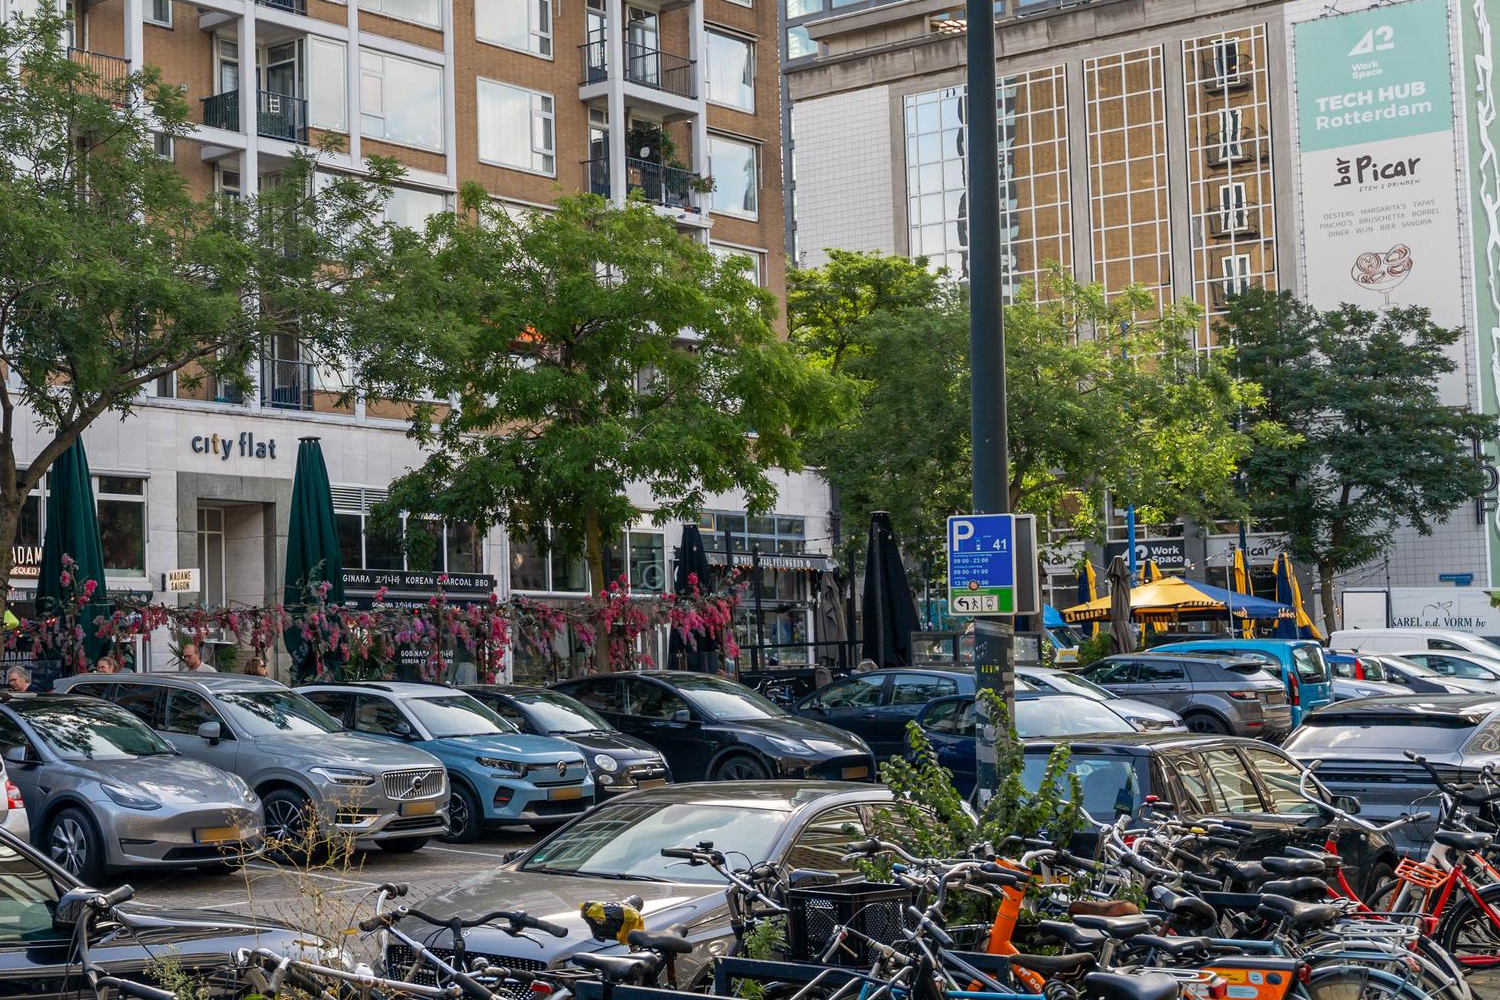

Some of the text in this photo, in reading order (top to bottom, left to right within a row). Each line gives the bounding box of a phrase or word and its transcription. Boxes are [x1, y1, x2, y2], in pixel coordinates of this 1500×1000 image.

[1352, 60, 1379, 71] Work
[1352, 68, 1383, 80] Space
[1316, 81, 1426, 112] TECH HUB
[1316, 101, 1432, 130] Rotterdam
[1334, 157, 1352, 187] bar
[1356, 155, 1421, 184] Picar
[1323, 199, 1436, 220] OESTERS MARGARITA'S TAPAS
[1319, 208, 1441, 230] PINCHO'S BRUSCHETTA BORREL
[1328, 230, 1350, 238] DINER
[1380, 223, 1397, 232] BIER
[1400, 218, 1433, 229] SANGRIA
[238, 431, 276, 459] flat
[953, 520, 975, 552] P
[992, 538, 1007, 550] 41
[1151, 546, 1179, 555] Work
[1151, 555, 1184, 565] Space
[169, 571, 192, 581] MADAME
[405, 577, 434, 585] KOREAN
[170, 581, 190, 591] SAIGON
[1392, 617, 1486, 627] KAREL v.d. VORM bv
